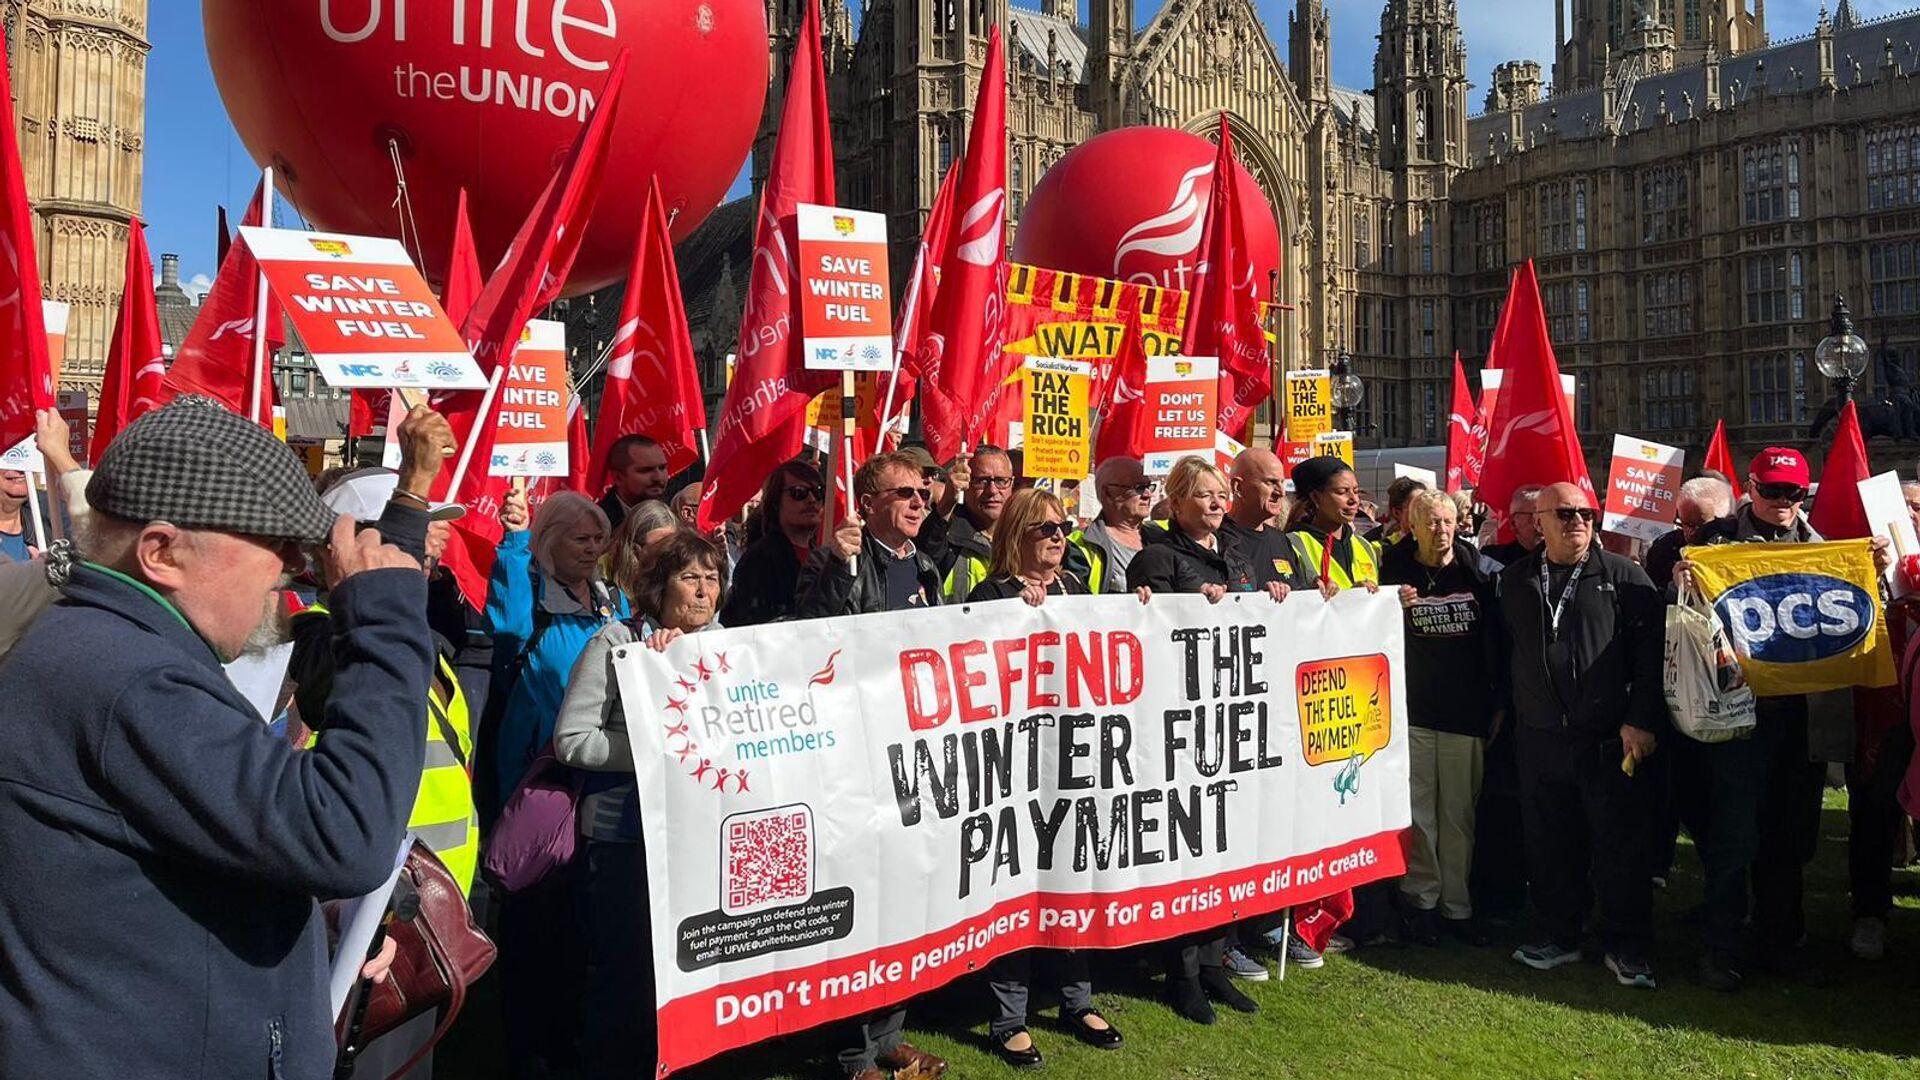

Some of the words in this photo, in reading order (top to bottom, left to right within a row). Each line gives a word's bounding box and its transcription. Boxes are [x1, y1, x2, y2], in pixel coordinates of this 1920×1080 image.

[820, 255, 871, 276] SAVE
[304, 273, 400, 295] SAVE
[808, 277, 884, 300] WINTER
[291, 294, 437, 319] WINTER
[825, 303, 872, 324] FUEL
[334, 319, 427, 340] FUEL
[1042, 324, 1183, 357] WATOR
[815, 348, 838, 361] NPC
[338, 363, 383, 377] NPC
[507, 364, 547, 384] AVE
[1031, 371, 1070, 395] TAX
[1291, 379, 1317, 391] TAX
[503, 387, 560, 407] INTER
[1031, 393, 1069, 415] THE
[1160, 393, 1205, 406] DON'T
[1292, 392, 1317, 404] THE
[497, 411, 546, 430] FUEL
[1158, 410, 1183, 421] LET
[1187, 410, 1205, 421] US
[1293, 404, 1326, 417] RICH
[1031, 414, 1081, 437] RICH
[1155, 426, 1207, 438] FREEZE
[1319, 442, 1342, 456] TAX
[1152, 460, 1170, 469] NPC
[1626, 466, 1666, 484] SAVE
[1615, 478, 1673, 501] WINTER
[1623, 495, 1660, 512] FUEL
[1411, 605, 1449, 617] DEFEND
[1451, 602, 1470, 611] THE
[1412, 614, 1451, 627] WINTER
[1454, 611, 1476, 622] FUEL
[1422, 621, 1469, 633] PAYMENT
[1725, 589, 1859, 658] pcs
[898, 630, 1144, 732] DEFEND
[1170, 624, 1269, 701] THE
[1301, 666, 1347, 696] DEFEND
[727, 680, 780, 703] unite
[700, 691, 818, 738] Retired
[1305, 699, 1325, 726] THE
[1328, 694, 1357, 721] FUEL
[735, 729, 836, 761] members
[1308, 723, 1362, 756] PAYMENT
[886, 713, 1135, 827] WINTER
[1163, 700, 1283, 782] FUEL
[958, 778, 1238, 900] PAYMENT
[682, 929, 700, 941] Join
[702, 924, 716, 934] the
[717, 916, 762, 933] campaign
[763, 913, 772, 922] to
[773, 908, 806, 921] defend
[806, 905, 821, 915] the
[822, 899, 849, 912] winter
[689, 939, 707, 951] fuel
[709, 932, 748, 947] payment
[756, 926, 775, 937] scan
[776, 921, 792, 931] the
[793, 919, 807, 930] QR
[831, 913, 841, 921] or
[715, 979, 811, 1027] Don't
[819, 955, 903, 1001] make
[909, 906, 1030, 982] pensioners
[1039, 906, 1095, 934] pay
[1105, 901, 1142, 927] for
[1151, 902, 1165, 920] a
[1171, 884, 1222, 915] crisis
[1229, 881, 1256, 903] we
[1262, 866, 1291, 895] did
[1296, 864, 1324, 886] not
[1329, 846, 1378, 877] create.
